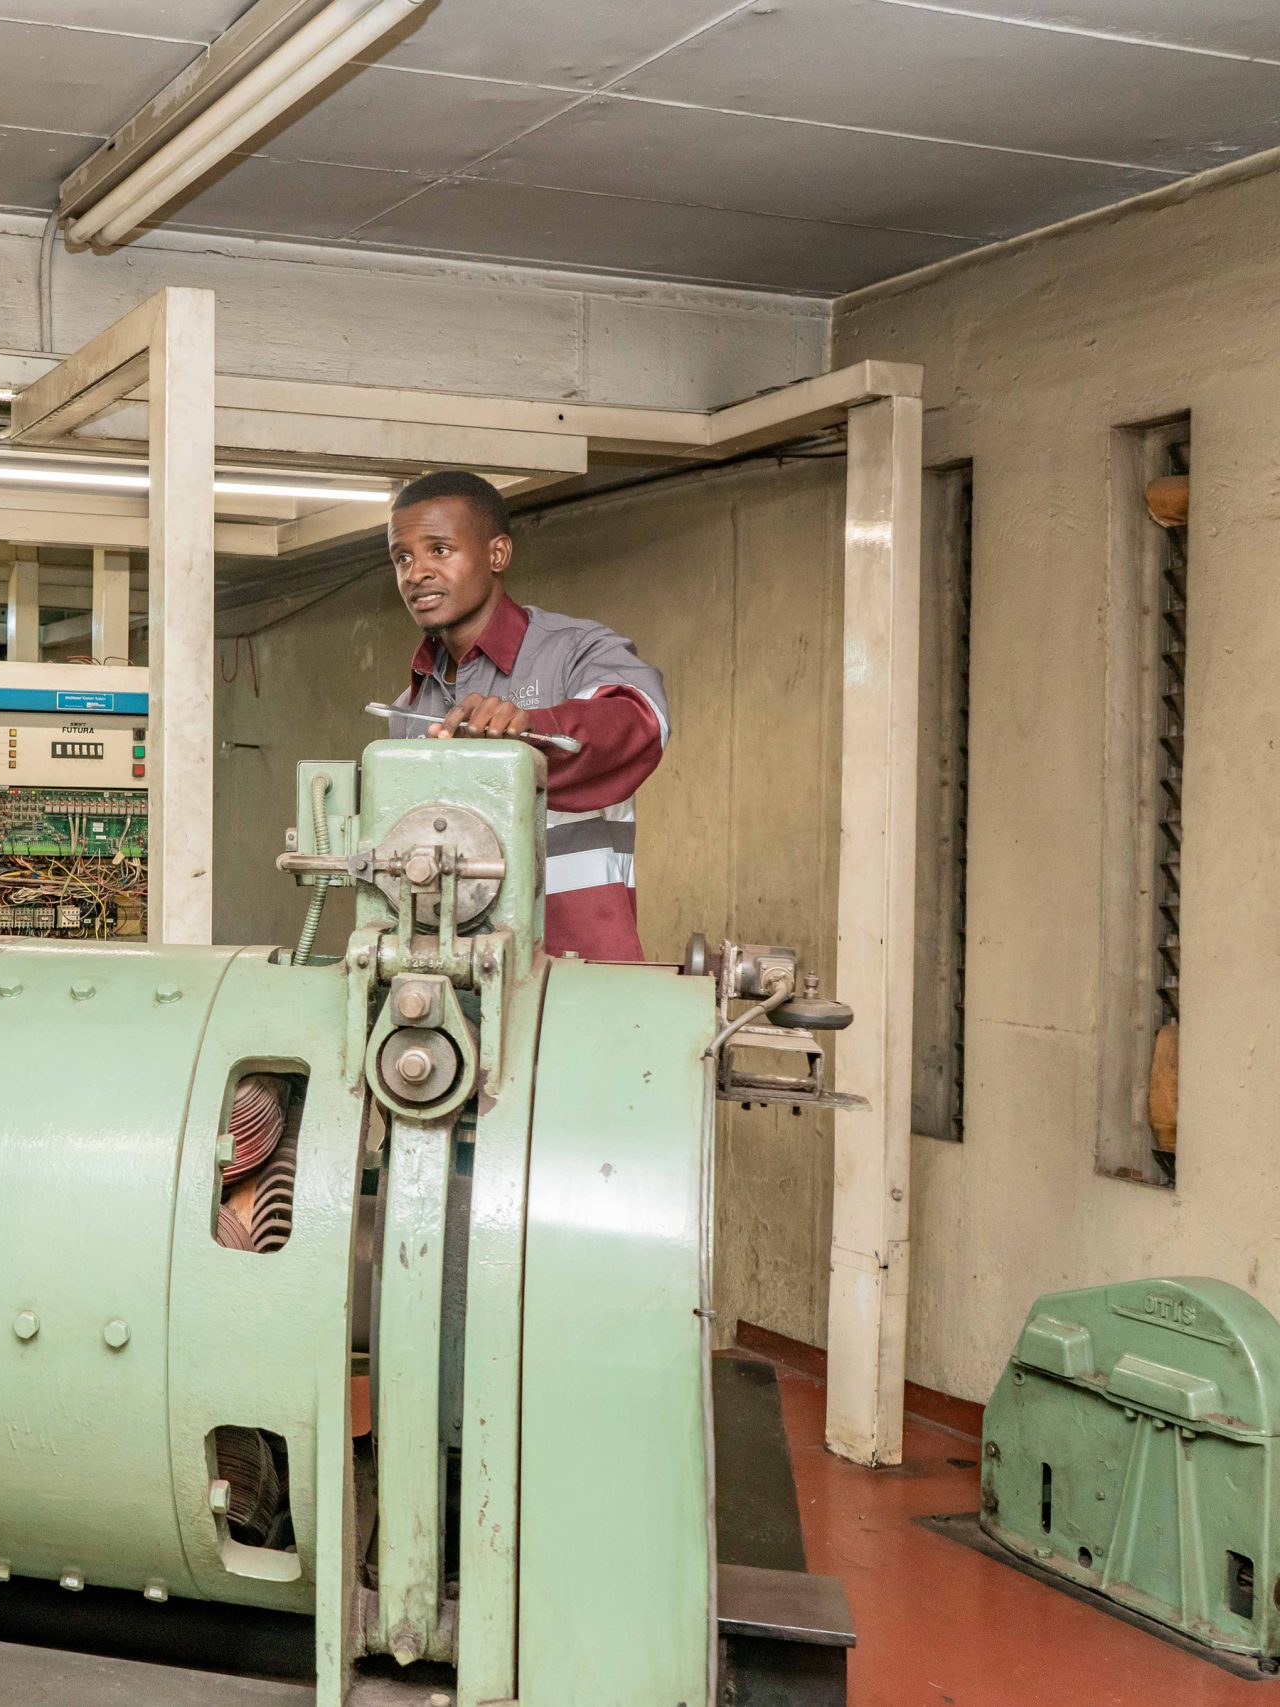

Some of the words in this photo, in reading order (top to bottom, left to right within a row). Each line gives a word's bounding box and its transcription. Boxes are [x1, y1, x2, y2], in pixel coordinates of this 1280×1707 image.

[509, 679, 539, 699] xcel
[62, 726, 95, 734] FUTURA
[1144, 1294, 1196, 1326] OTIS
